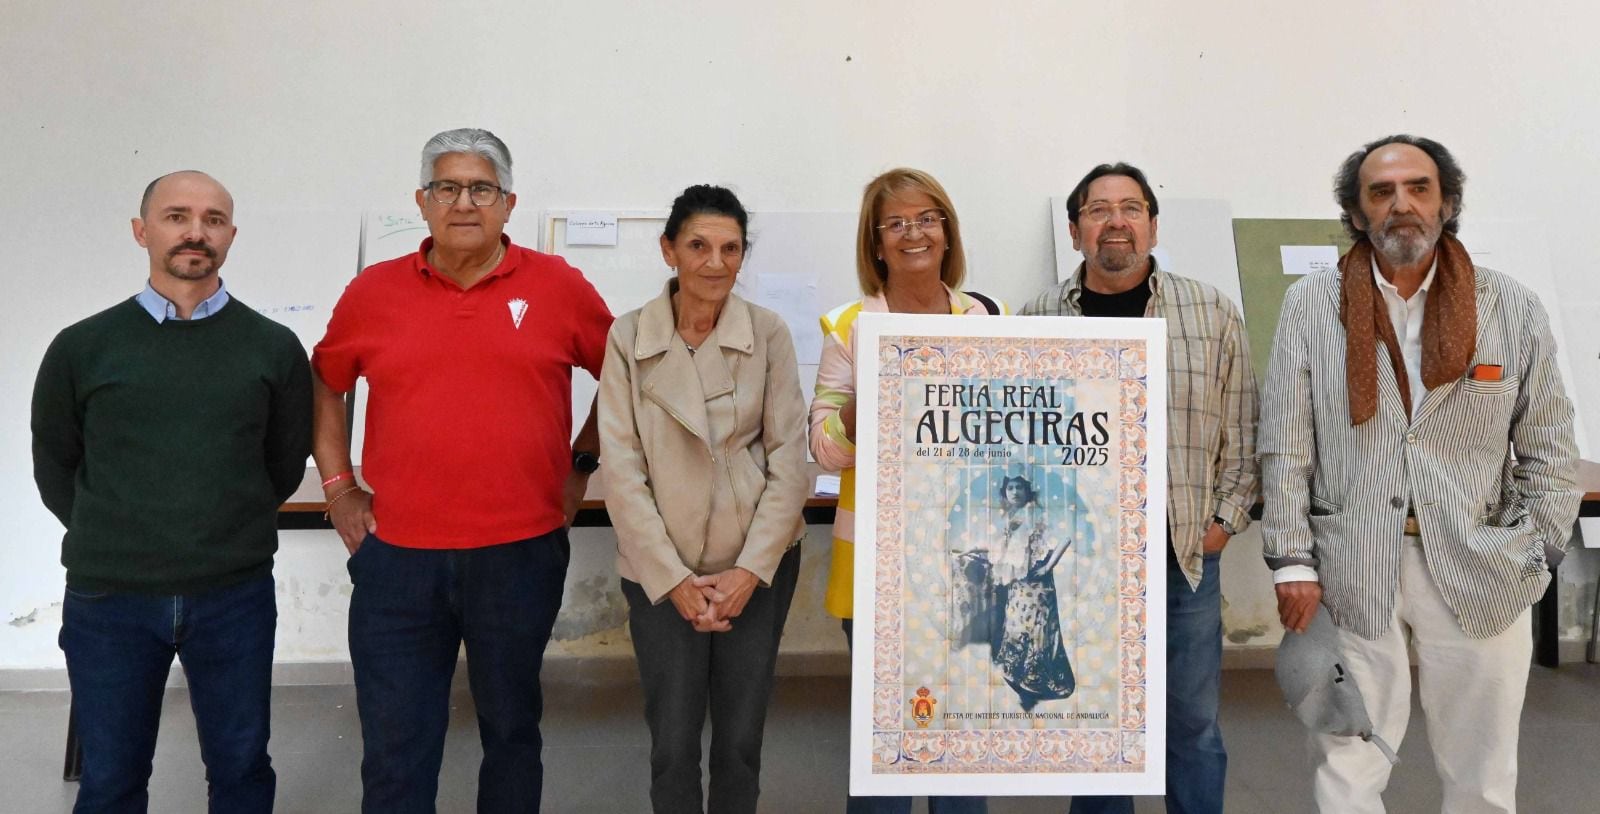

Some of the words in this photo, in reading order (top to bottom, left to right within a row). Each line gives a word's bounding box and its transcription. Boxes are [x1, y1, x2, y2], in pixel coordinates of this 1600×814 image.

[924, 384, 992, 407] FERIA
[1002, 385, 1061, 408] REAL
[916, 410, 1109, 445] ALGECIRAS
[916, 447, 930, 457] del
[933, 447, 943, 457] 21
[946, 447, 955, 457] al
[958, 447, 970, 458] 28
[973, 448, 984, 458] de
[987, 448, 1012, 459] junio
[1061, 447, 1109, 466] 2025
[943, 712, 964, 720] FIESTA
[965, 712, 974, 720] DE
[1035, 712, 1065, 720] NACIONAL
[1066, 712, 1075, 720] DE
